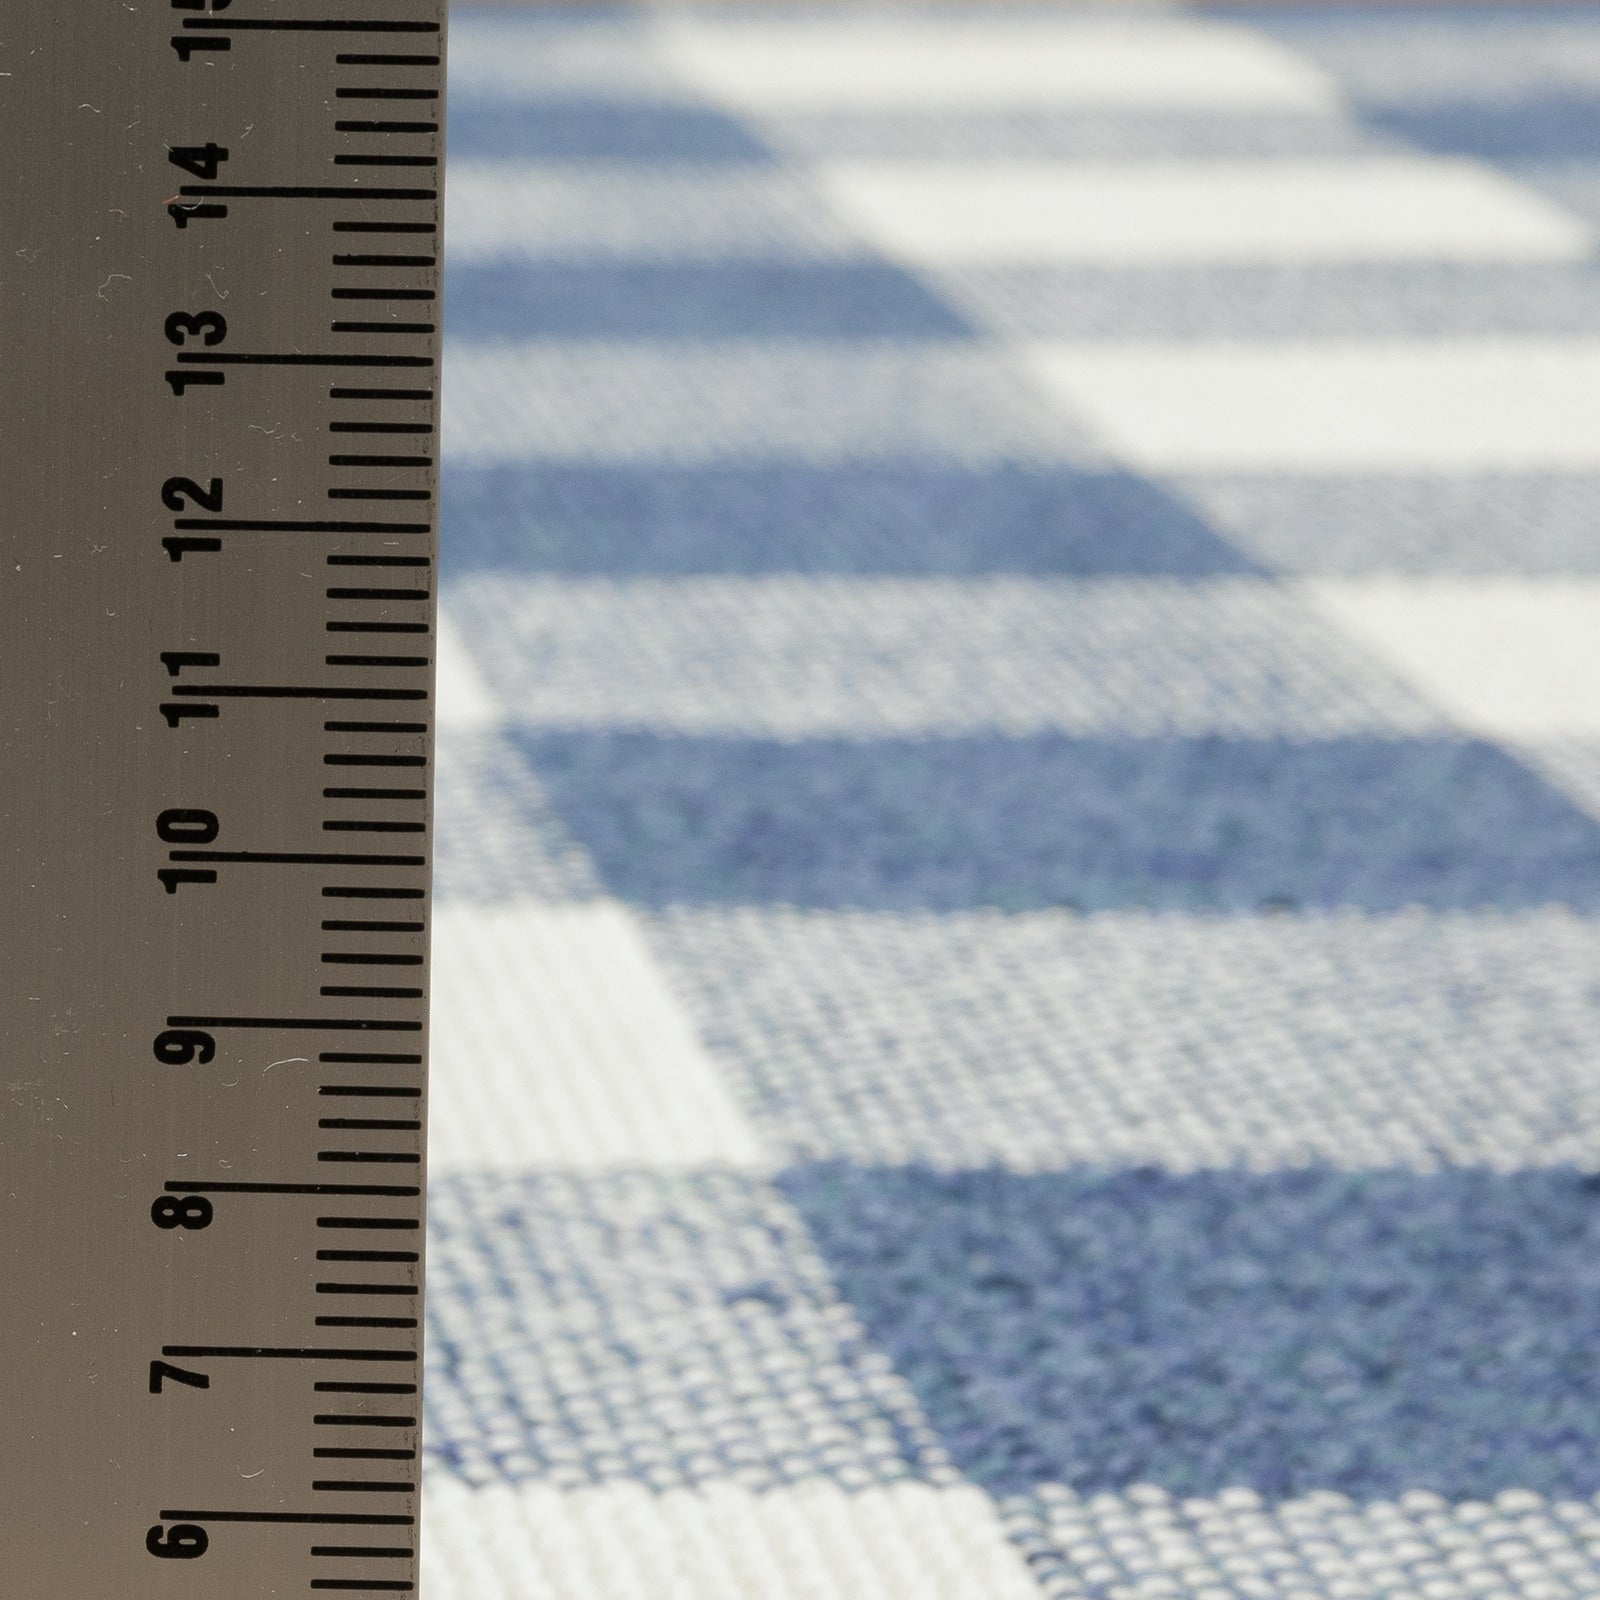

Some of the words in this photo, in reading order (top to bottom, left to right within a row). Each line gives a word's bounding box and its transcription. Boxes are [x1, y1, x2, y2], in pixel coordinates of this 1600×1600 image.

[167, 141, 230, 230] 14
[163, 310, 228, 397] 13
[160, 476, 224, 563] 12
[158, 651, 221, 729] 11
[155, 808, 220, 895] 10
[152, 1030, 216, 1066] 9
[150, 1196, 214, 1231] 8
[148, 1361, 210, 1394] 7
[145, 1524, 209, 1560] 6
